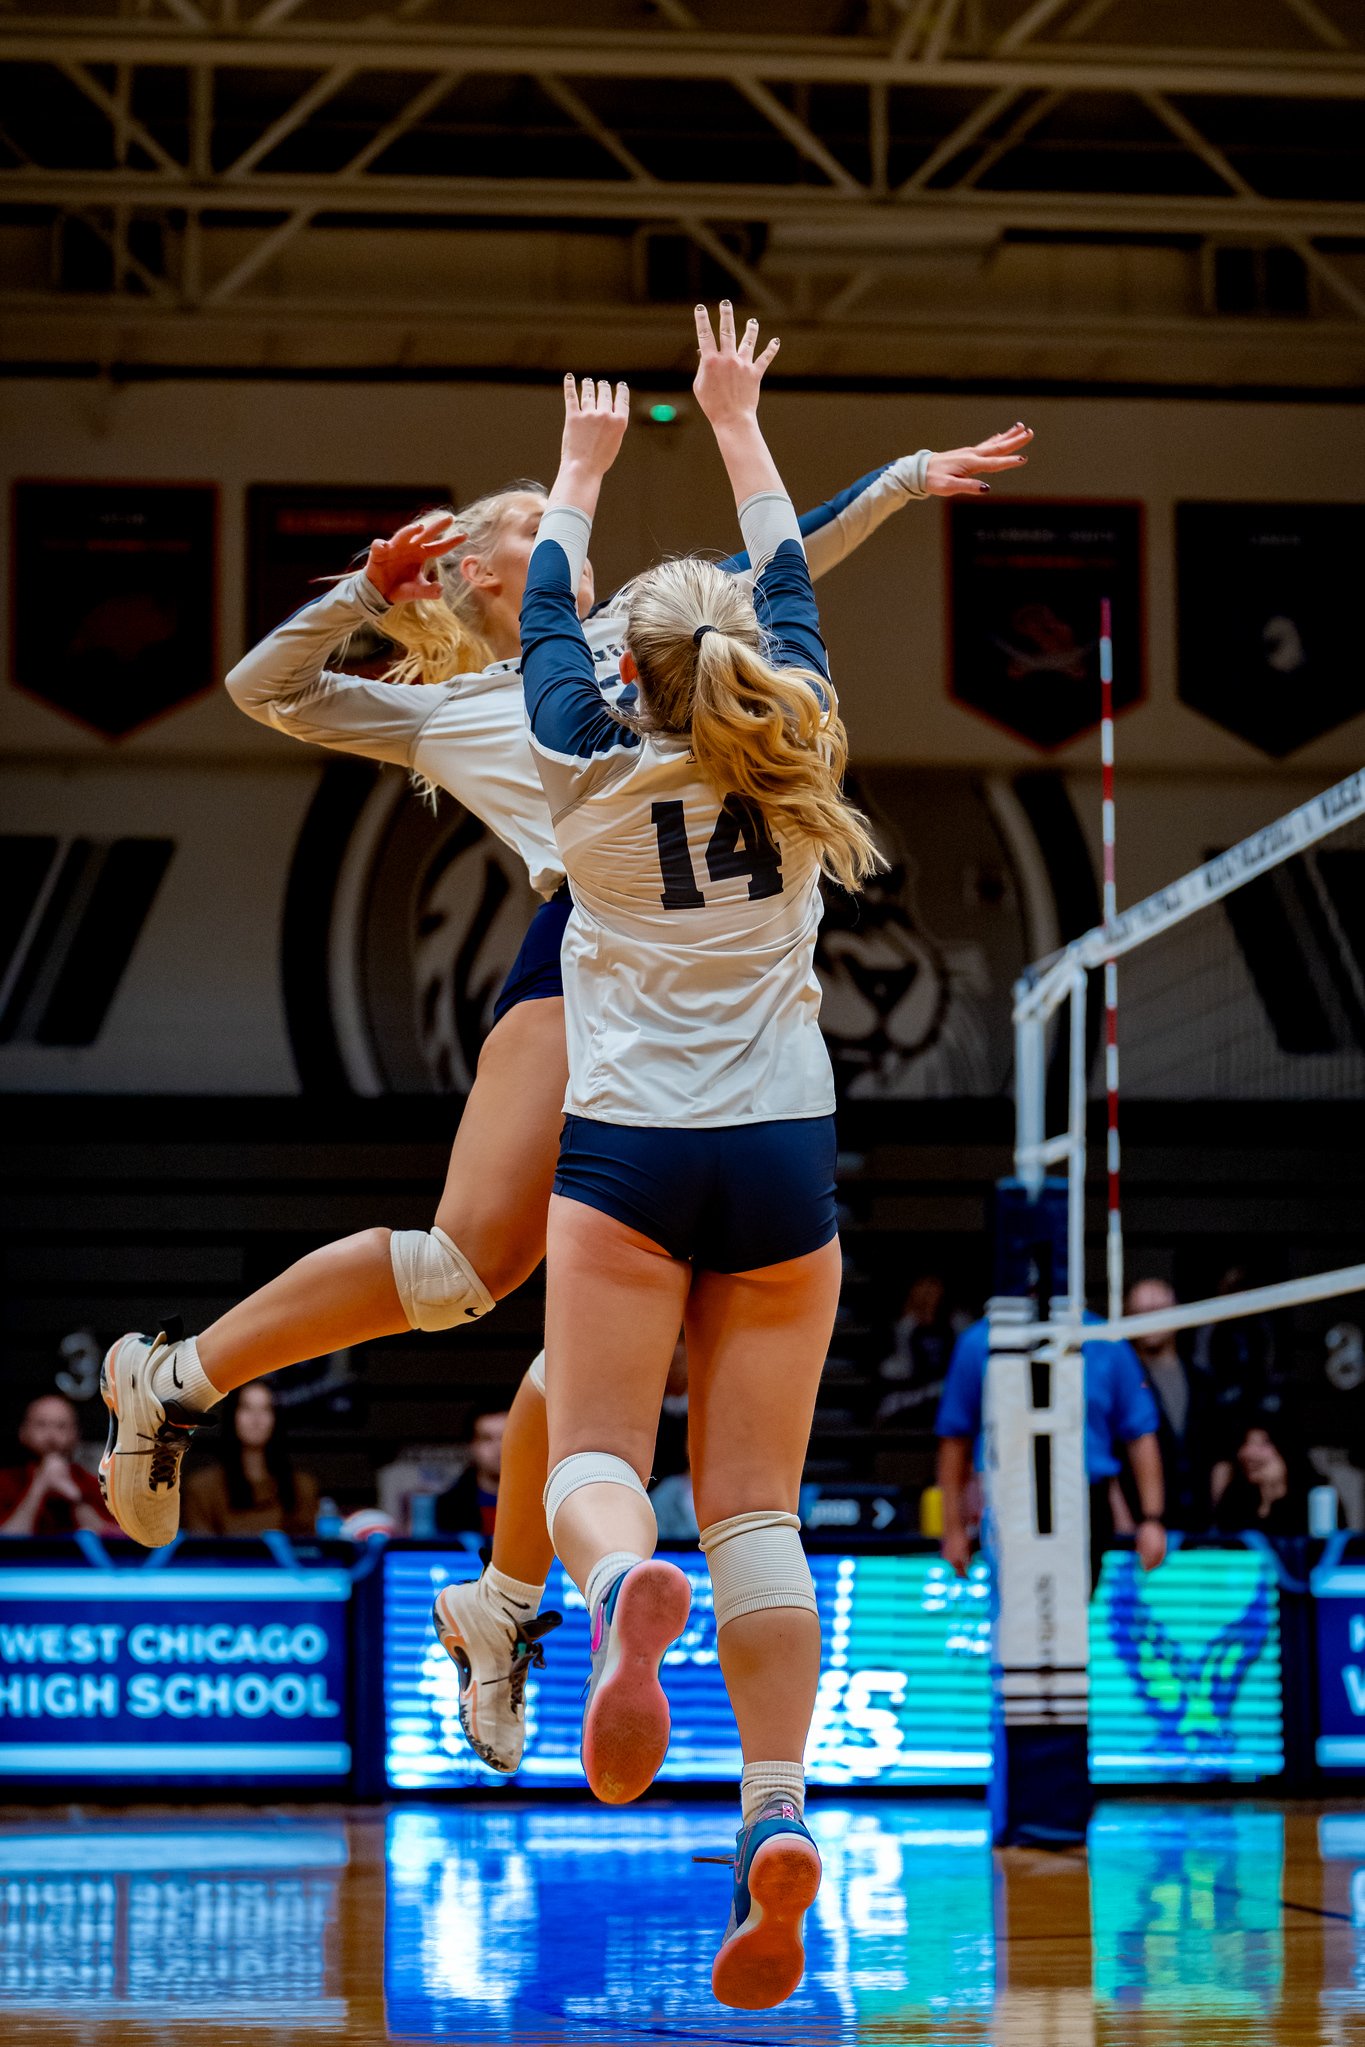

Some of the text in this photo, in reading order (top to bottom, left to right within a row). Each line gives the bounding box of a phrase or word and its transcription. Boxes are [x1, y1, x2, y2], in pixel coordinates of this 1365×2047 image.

[651, 790, 784, 910] 14
[1, 1623, 328, 1664] WEST CHICAGO
[127, 1673, 338, 1717] SCHOOL
